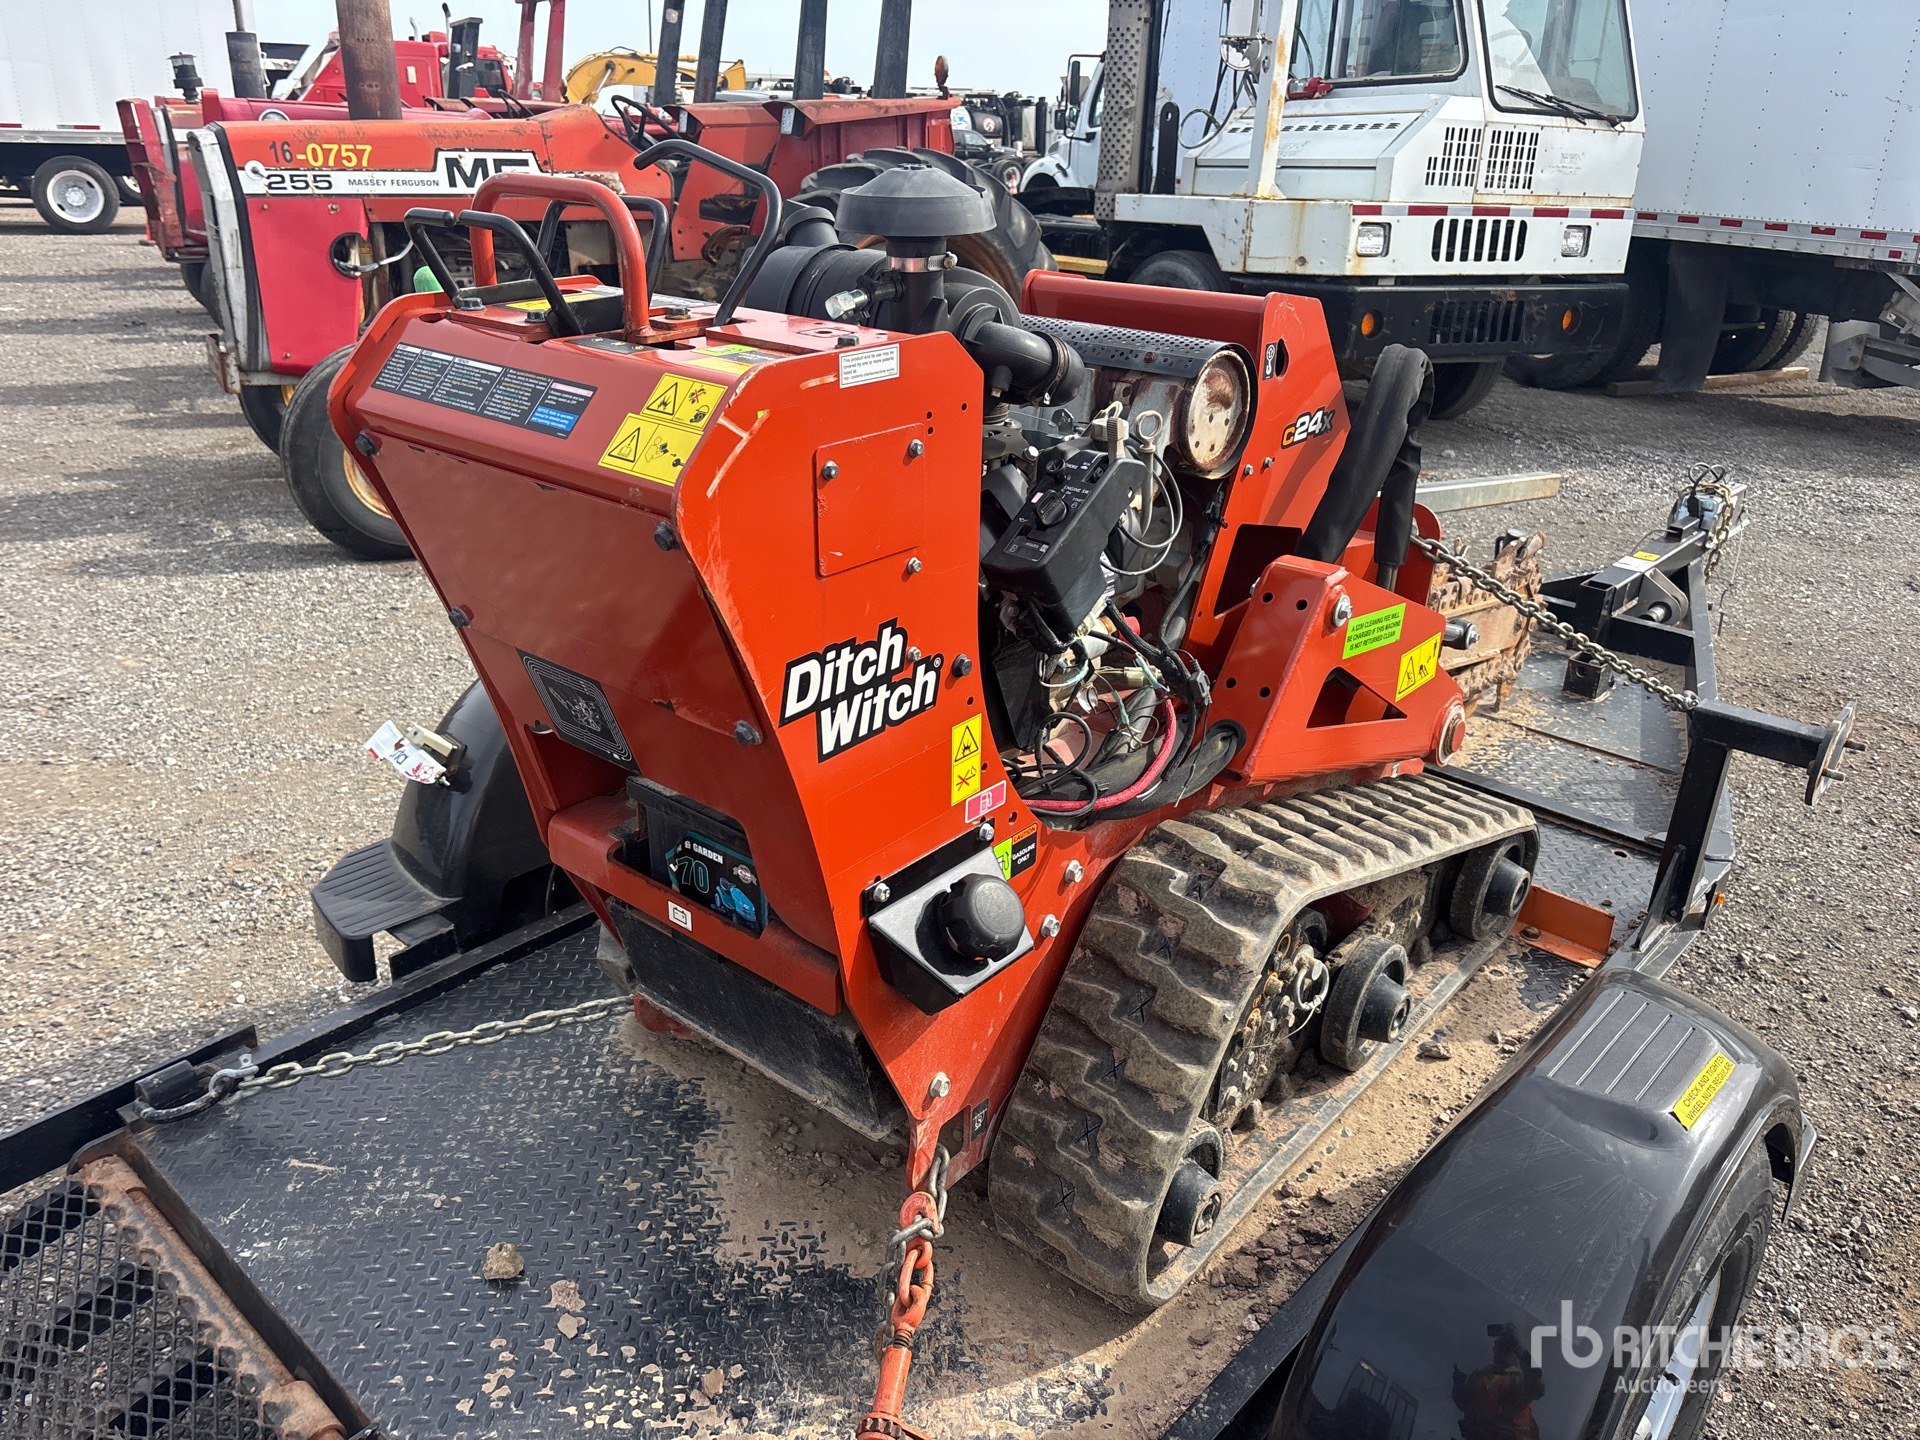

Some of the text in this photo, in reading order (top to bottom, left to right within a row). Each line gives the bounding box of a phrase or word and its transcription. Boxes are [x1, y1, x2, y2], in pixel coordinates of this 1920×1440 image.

[269, 141, 373, 168] 16-0757
[266, 174, 333, 190] 255
[348, 178, 387, 187] MASSEY
[390, 179, 440, 187] FERGUSON
[1364, 616, 1384, 629] CLEANING
[1353, 628, 1372, 640] CHARGED
[1363, 635, 1382, 646] RETURNED
[784, 626, 904, 718] Ditch
[1014, 826, 1036, 842] CAUTION
[692, 843, 723, 864] GARDEN
[1012, 842, 1036, 860] GASOLINE
[1017, 853, 1030, 864] ONLY
[676, 856, 709, 894] 70
[1683, 1055, 1725, 1108] CHECK AND TIGHTEN
[1686, 1100, 1705, 1121] WHEEL
[1702, 1084, 1716, 1102] NUTS
